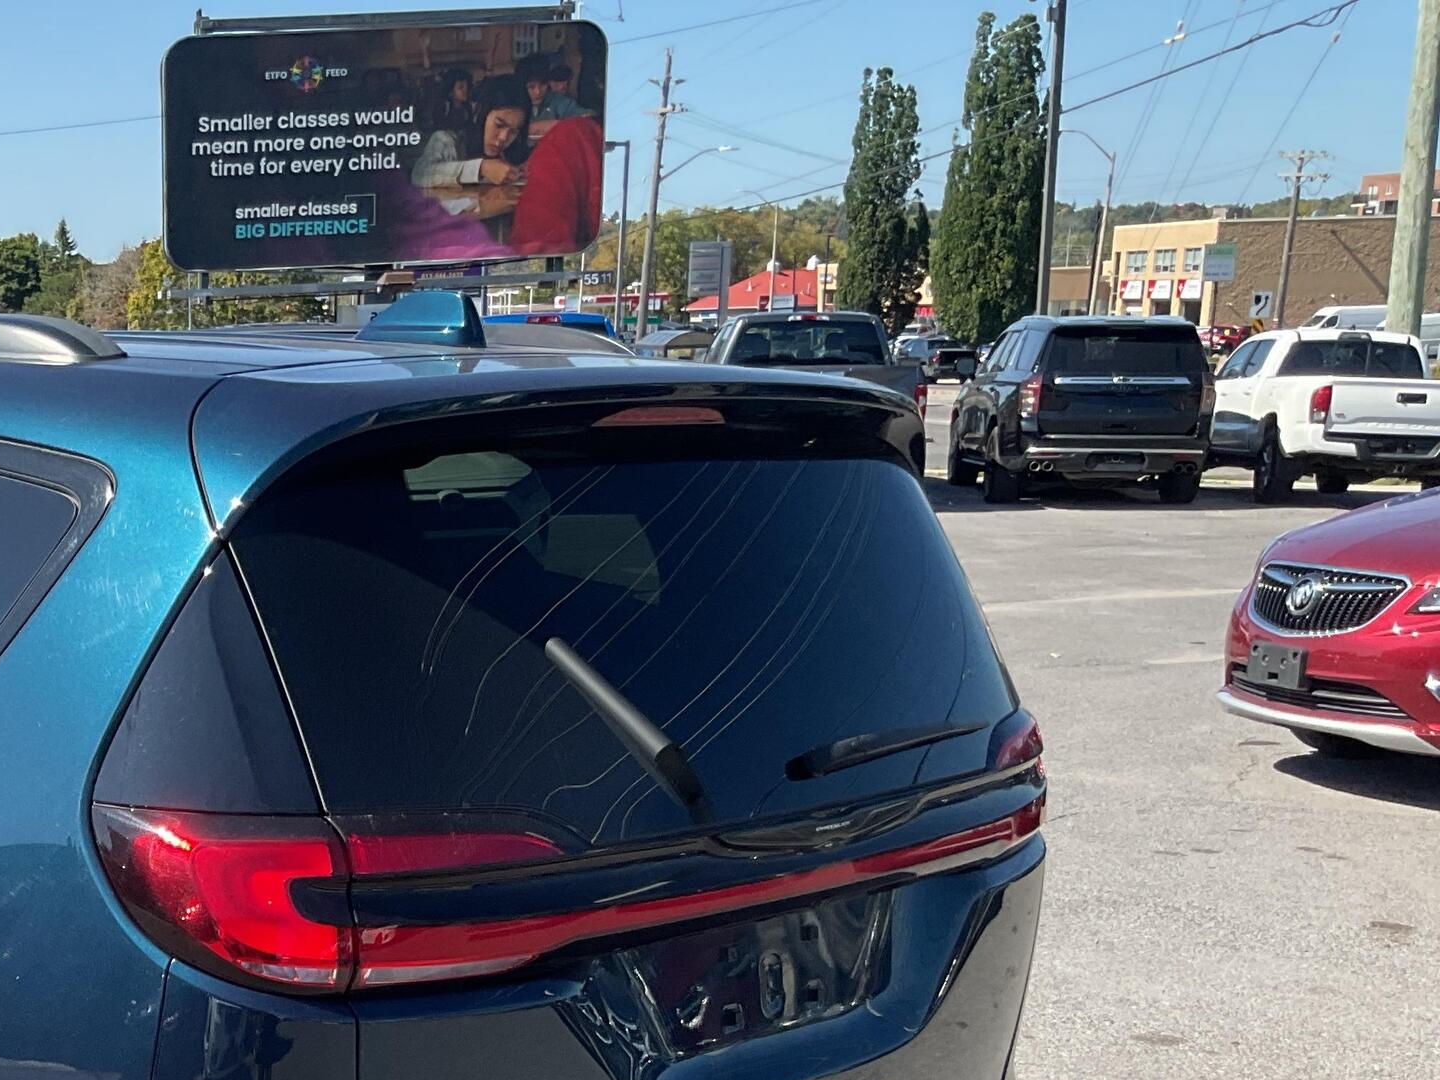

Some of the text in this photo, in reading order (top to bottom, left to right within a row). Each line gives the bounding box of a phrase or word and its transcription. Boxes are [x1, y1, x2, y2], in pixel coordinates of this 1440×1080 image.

[265, 71, 288, 80] ETFO
[198, 106, 414, 132] Smaller classes would
[191, 132, 421, 155] mean more one-on-one
[210, 153, 401, 176] time for every child.
[235, 201, 357, 219] smaller classes
[235, 219, 368, 239] BIG DIFFERENCE
